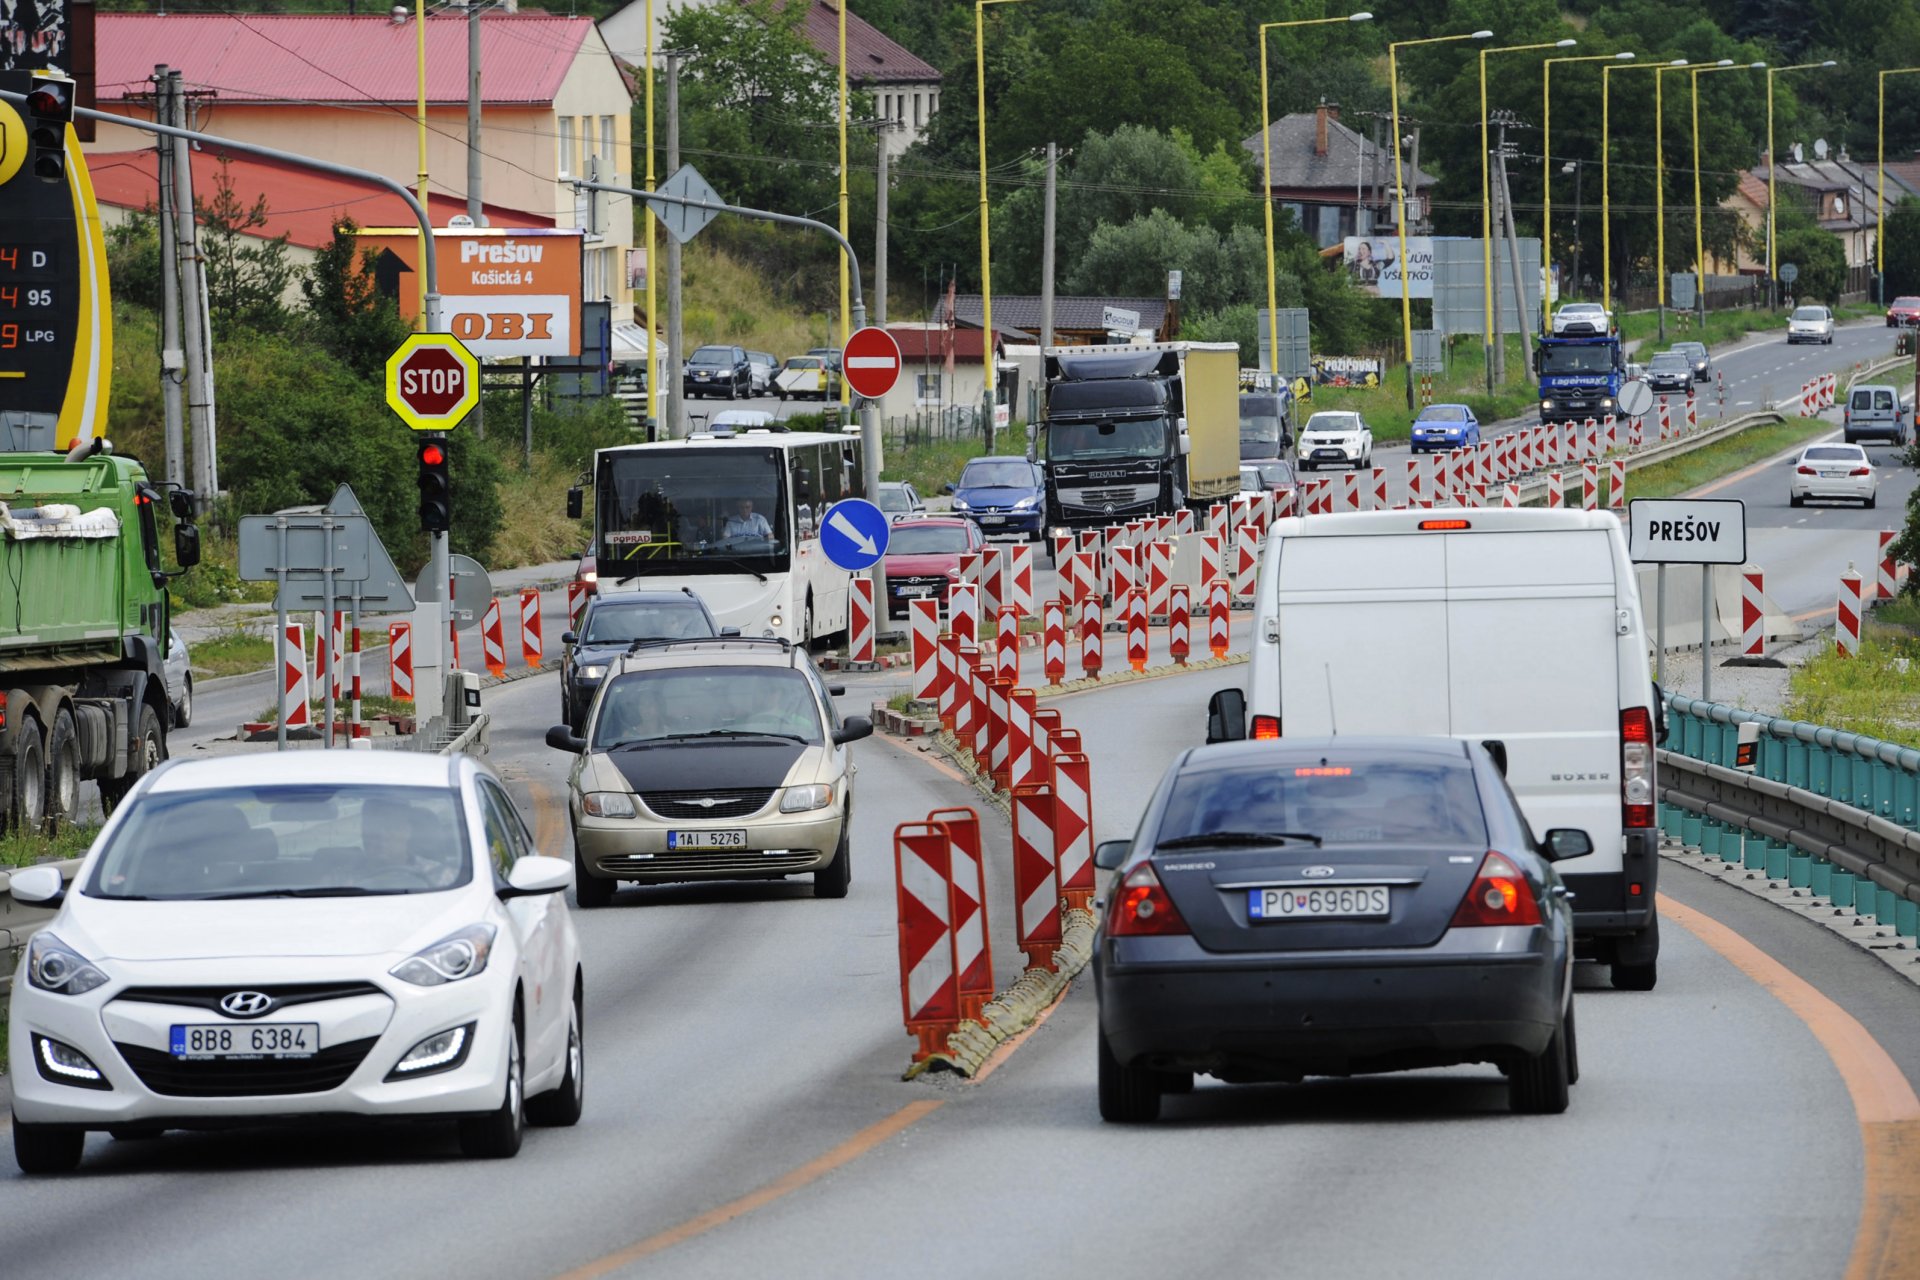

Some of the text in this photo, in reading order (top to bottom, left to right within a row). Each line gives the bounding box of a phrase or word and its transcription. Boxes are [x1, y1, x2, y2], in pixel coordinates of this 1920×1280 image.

[1, 248, 46, 270] 4 D
[461, 240, 543, 263] Prešov
[472, 269, 533, 285] Košická 4
[1, 287, 51, 308] 4 95
[1, 324, 55, 348] 9 LPG
[451, 313, 553, 340] OBI
[404, 369, 461, 395] STOP
[1090, 470, 1125, 478] RENAULT
[1649, 515, 1720, 541] PREŠOV
[1551, 773, 1609, 781] BOXER
[711, 833, 740, 845] 5276
[1164, 862, 1216, 871] MONDEO
[191, 1028, 306, 1050] 8B8 6384
